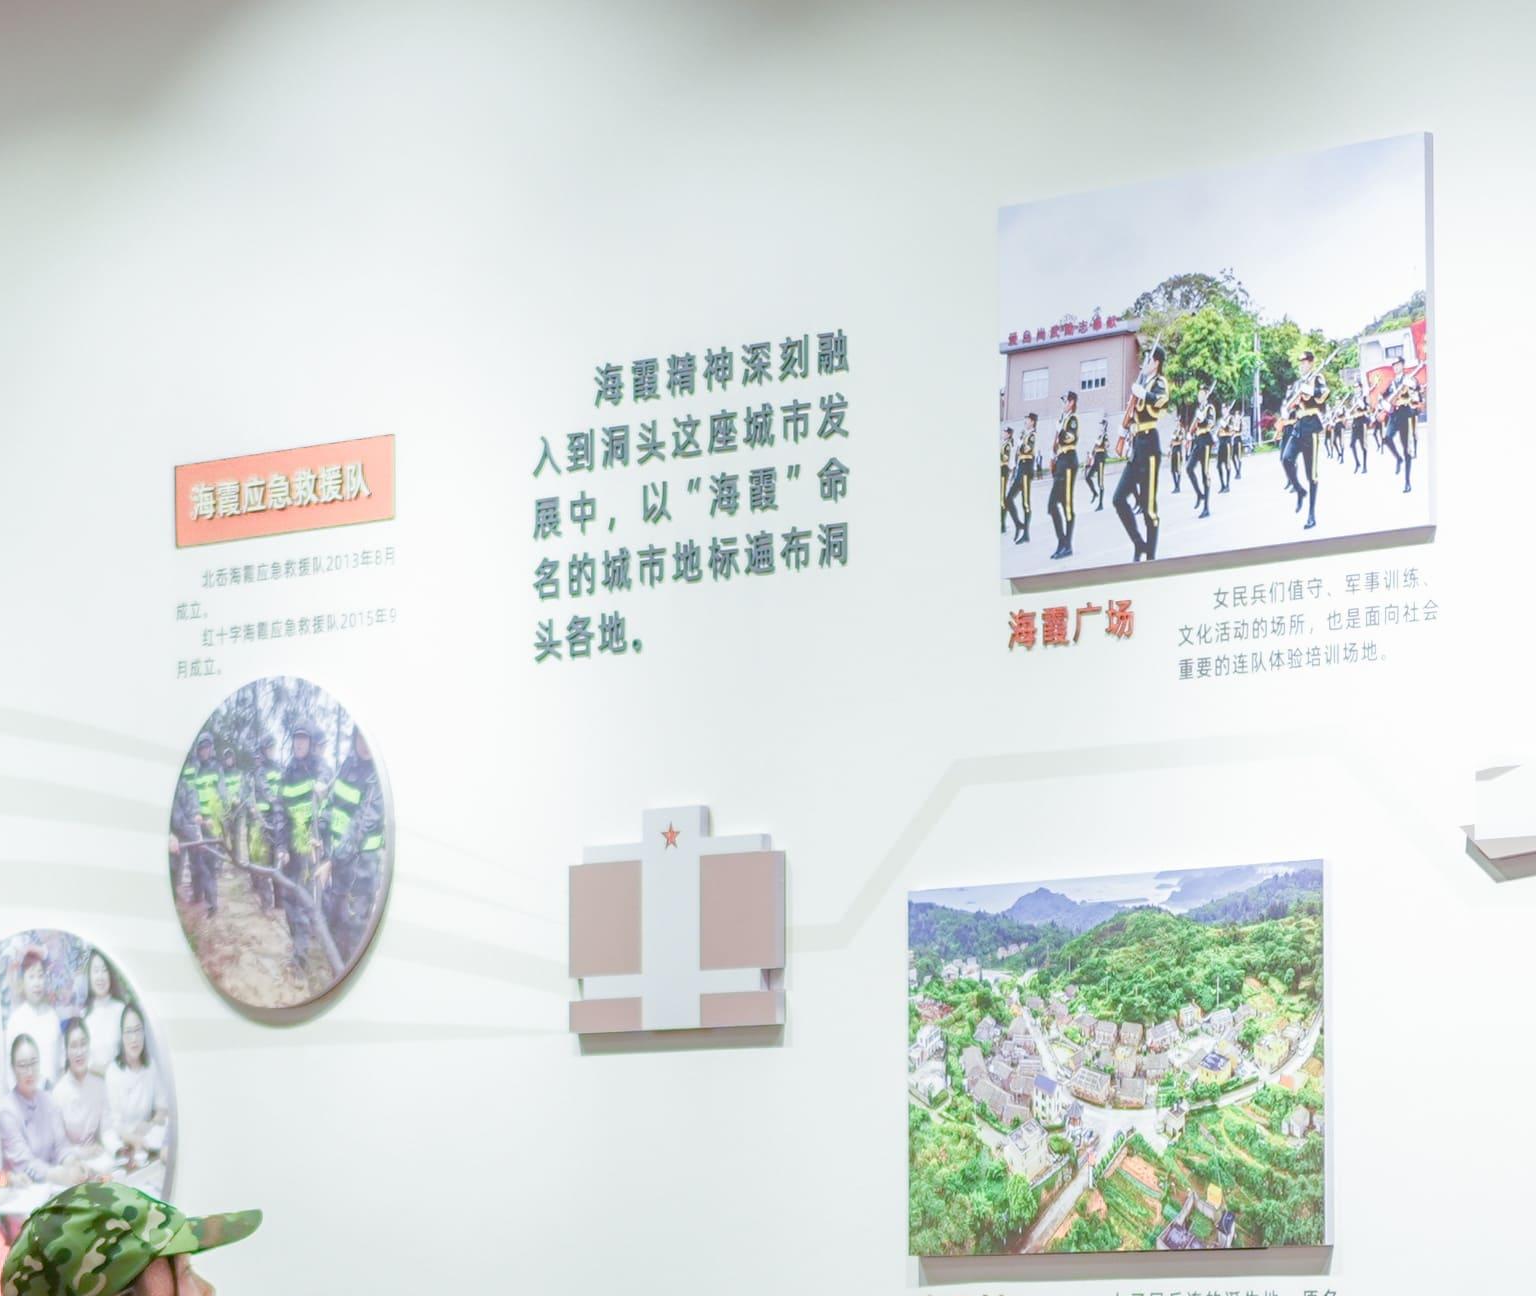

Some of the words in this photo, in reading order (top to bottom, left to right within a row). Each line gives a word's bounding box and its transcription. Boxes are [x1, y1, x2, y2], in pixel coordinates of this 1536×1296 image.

[594, 329, 850, 408] 海霞精神深刻融
[533, 391, 850, 478] 入到洞头这座城市发
[190, 461, 372, 521] 海霞应急救援队
[533, 456, 851, 541] 展中，以“海霞”命
[533, 522, 849, 602] 名的城市地标遍布洞
[1213, 566, 1431, 610] 女民兵们值守、军事训练、
[534, 610, 643, 665] 头各地。
[1008, 600, 1136, 651] 海霞广场
[1178, 599, 1440, 647] 文化活动的场所，也是面向社会
[1178, 642, 1389, 681] 重要的连队体验培训场地。
